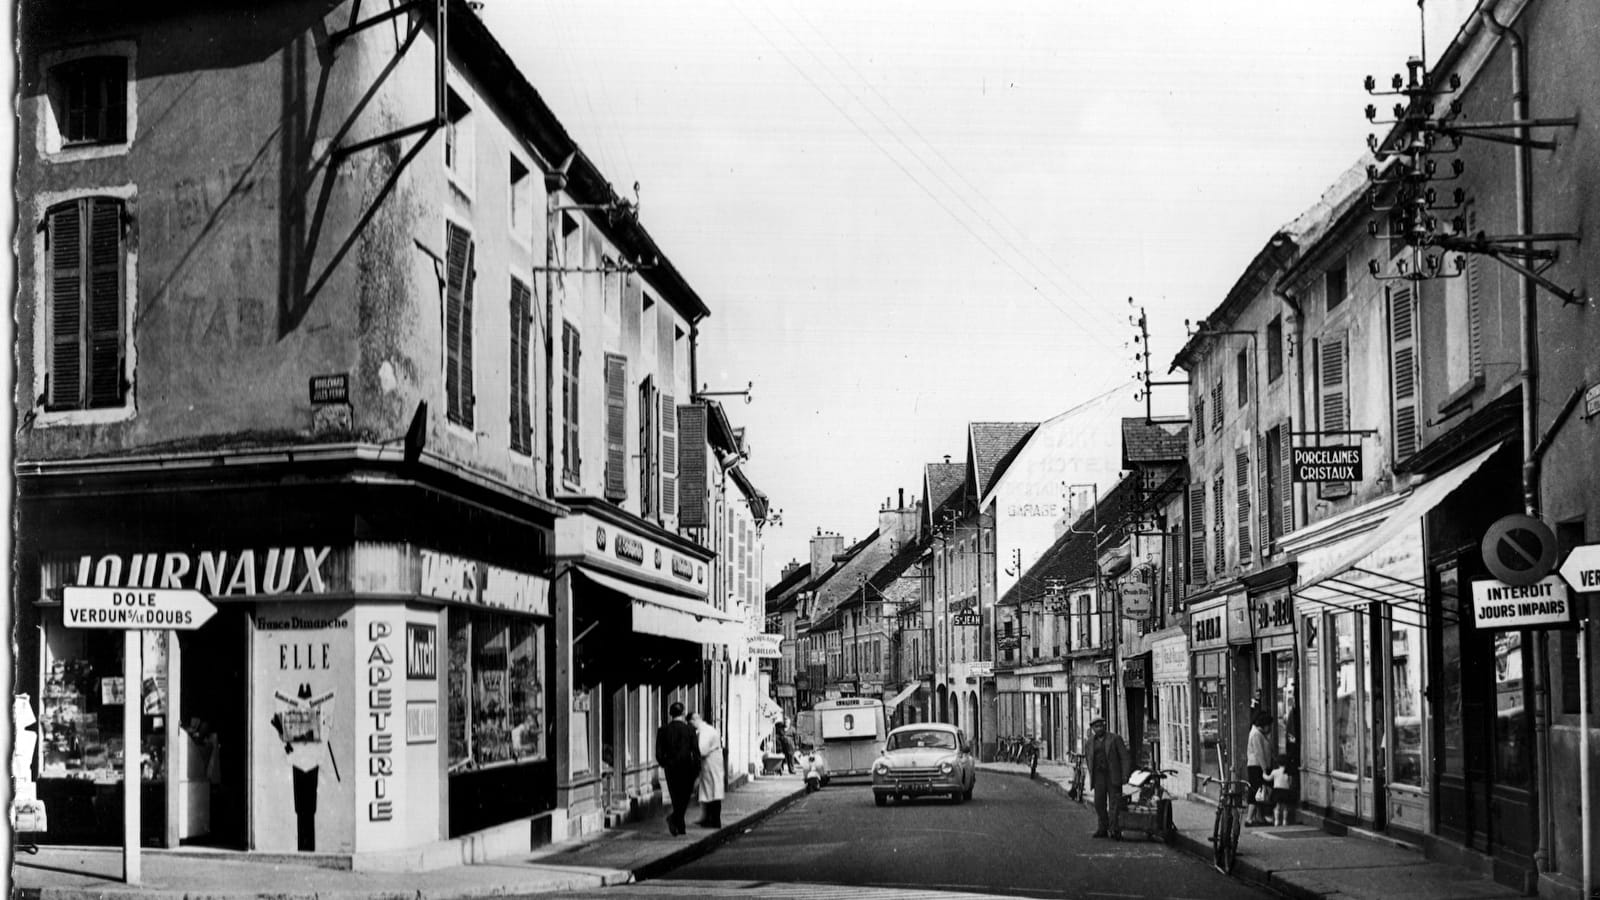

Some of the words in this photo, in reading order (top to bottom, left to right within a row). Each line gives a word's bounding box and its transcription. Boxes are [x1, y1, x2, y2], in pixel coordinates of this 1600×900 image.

[314, 377, 345, 389] BOULEVARD
[329, 388, 346, 400] FERRY
[1295, 449, 1360, 465] PORCELAINES
[1300, 465, 1355, 480] CRISTAUX
[1007, 503, 1057, 517] GARAGE
[113, 592, 156, 607] DOLE
[1487, 583, 1553, 601] INTERDIT
[70, 608, 127, 623] VERDUN
[146, 610, 193, 625] DOUBS
[1479, 604, 1516, 619] JOURS
[1518, 600, 1565, 617] IMPAIRS
[257, 617, 291, 631] France
[291, 616, 349, 630] Dimanche
[963, 615, 981, 625] JEAN
[279, 643, 330, 670] ELLE
[407, 626, 435, 676] MATCH
[368, 620, 394, 822] PAPETERIE
